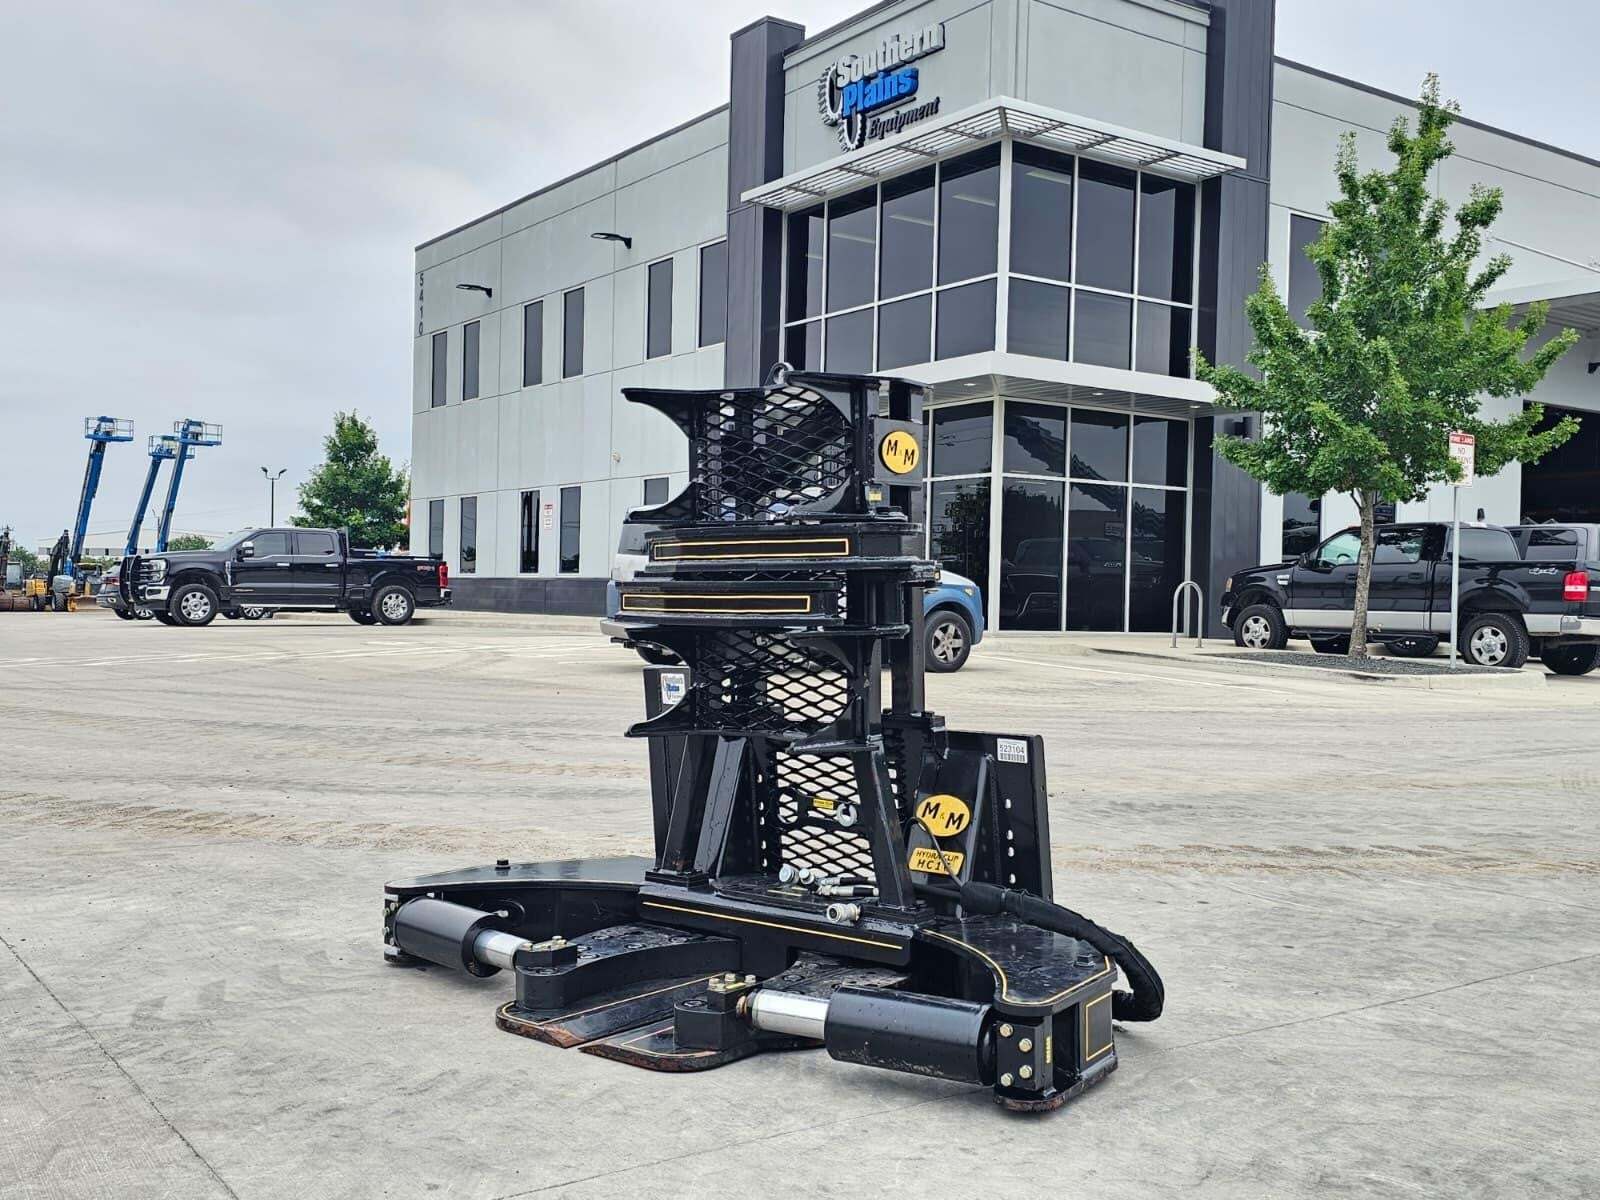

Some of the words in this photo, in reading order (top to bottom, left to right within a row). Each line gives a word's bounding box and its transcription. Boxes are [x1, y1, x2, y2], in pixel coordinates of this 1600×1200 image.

[836, 22, 945, 87] Southern
[842, 67, 918, 118] Plains
[868, 97, 940, 139] Equipment
